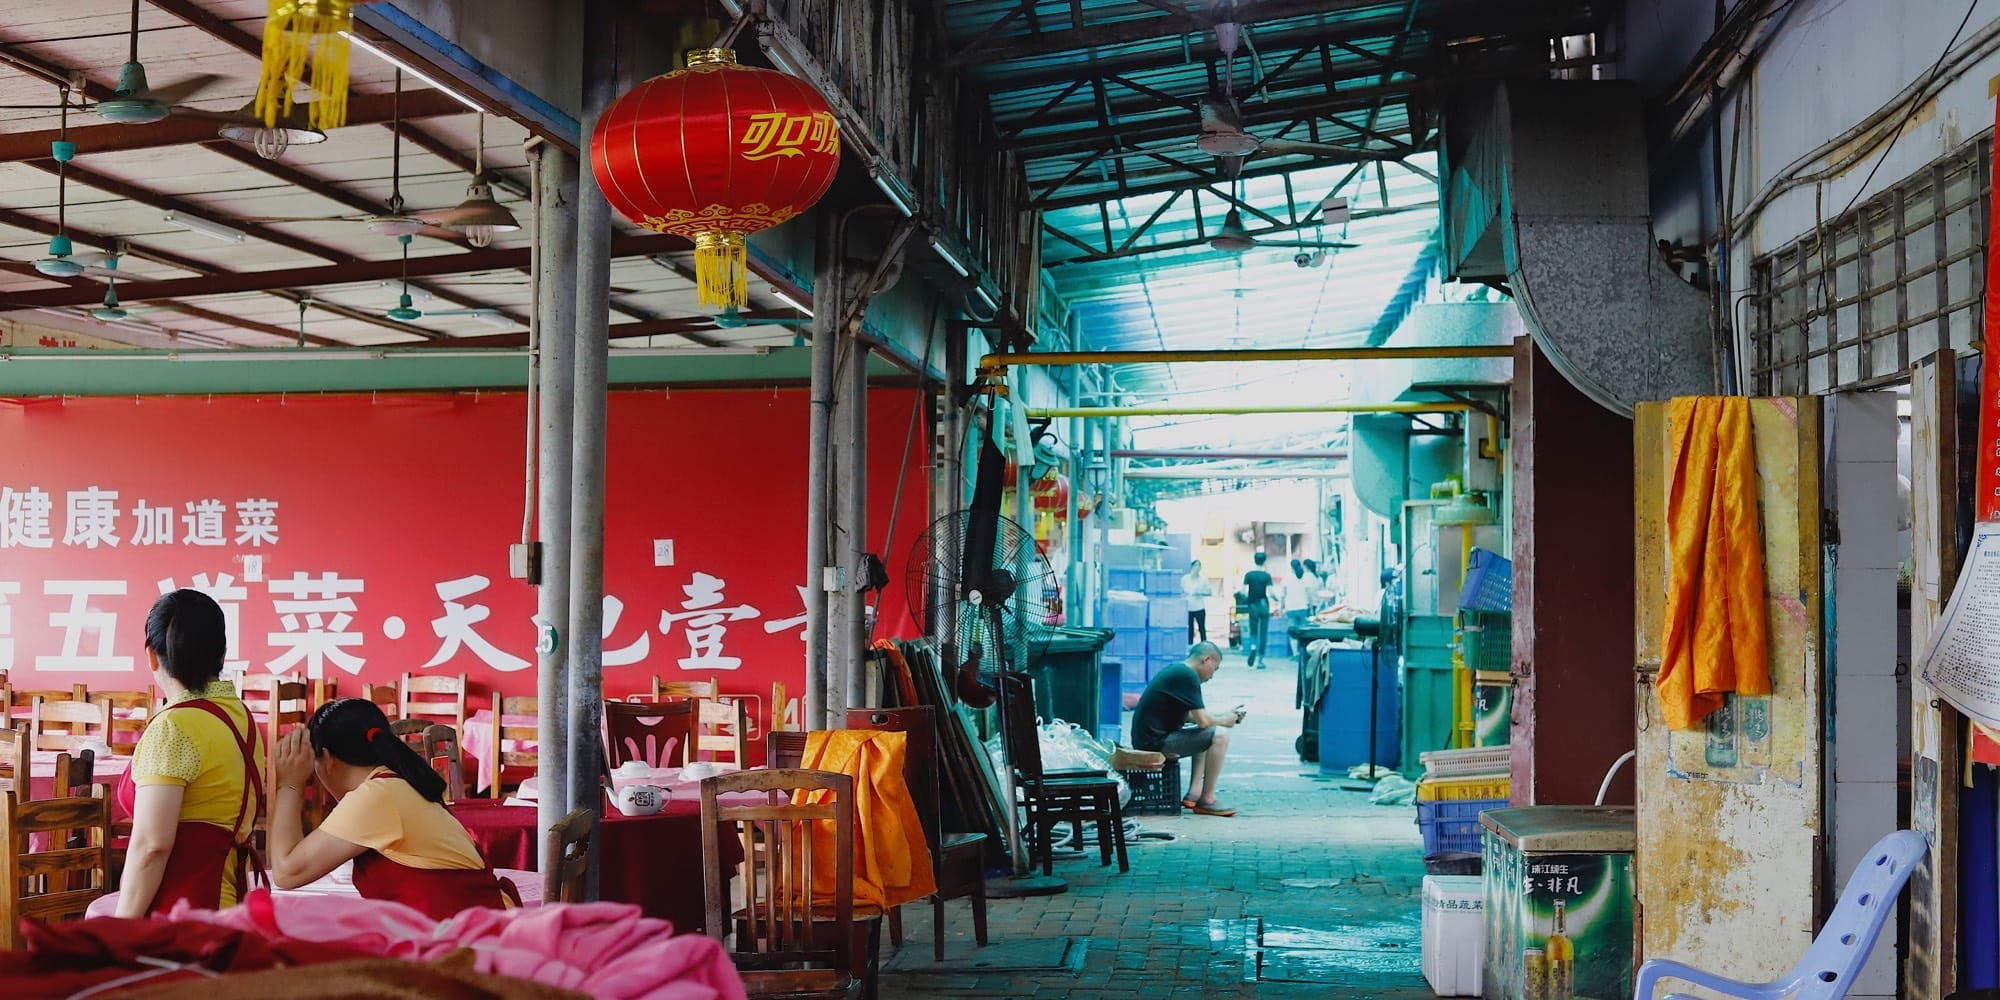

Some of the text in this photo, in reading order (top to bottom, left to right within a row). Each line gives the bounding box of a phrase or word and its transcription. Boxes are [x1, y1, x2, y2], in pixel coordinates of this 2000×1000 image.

[0, 486, 281, 549] 健康加道菜
